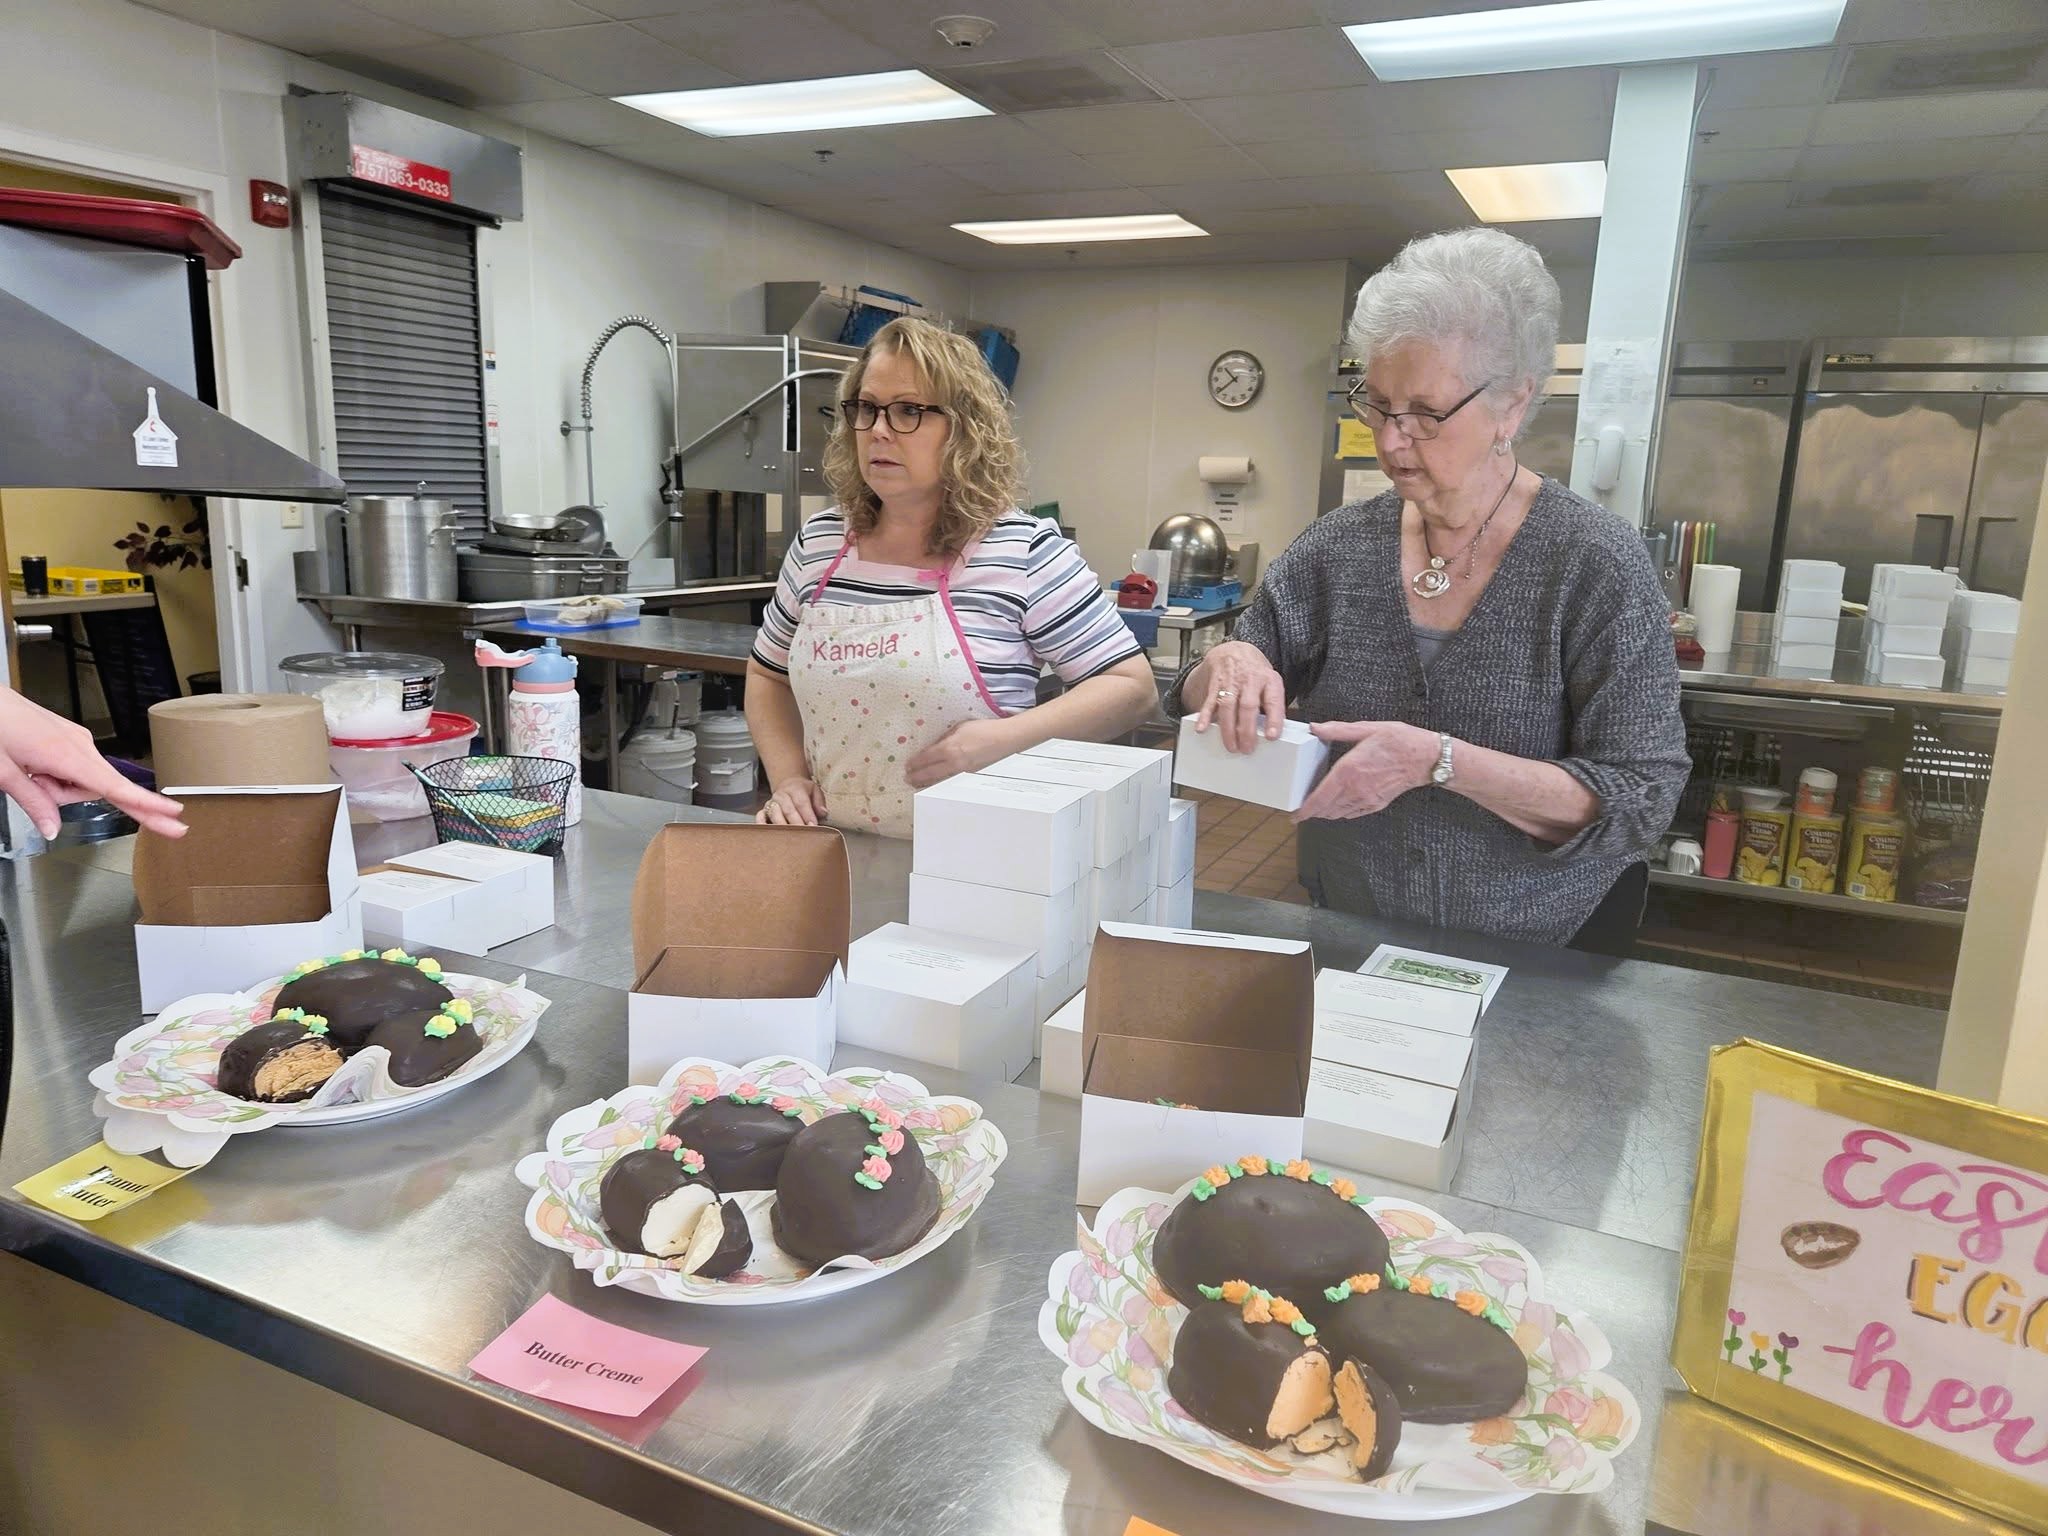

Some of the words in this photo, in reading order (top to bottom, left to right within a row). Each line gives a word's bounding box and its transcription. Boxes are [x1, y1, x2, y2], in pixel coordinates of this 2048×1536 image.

[813, 636, 898, 661] Kamela
[64, 1182, 118, 1207] utter
[524, 1341, 583, 1370] Butter
[585, 1362, 644, 1385] Creme
